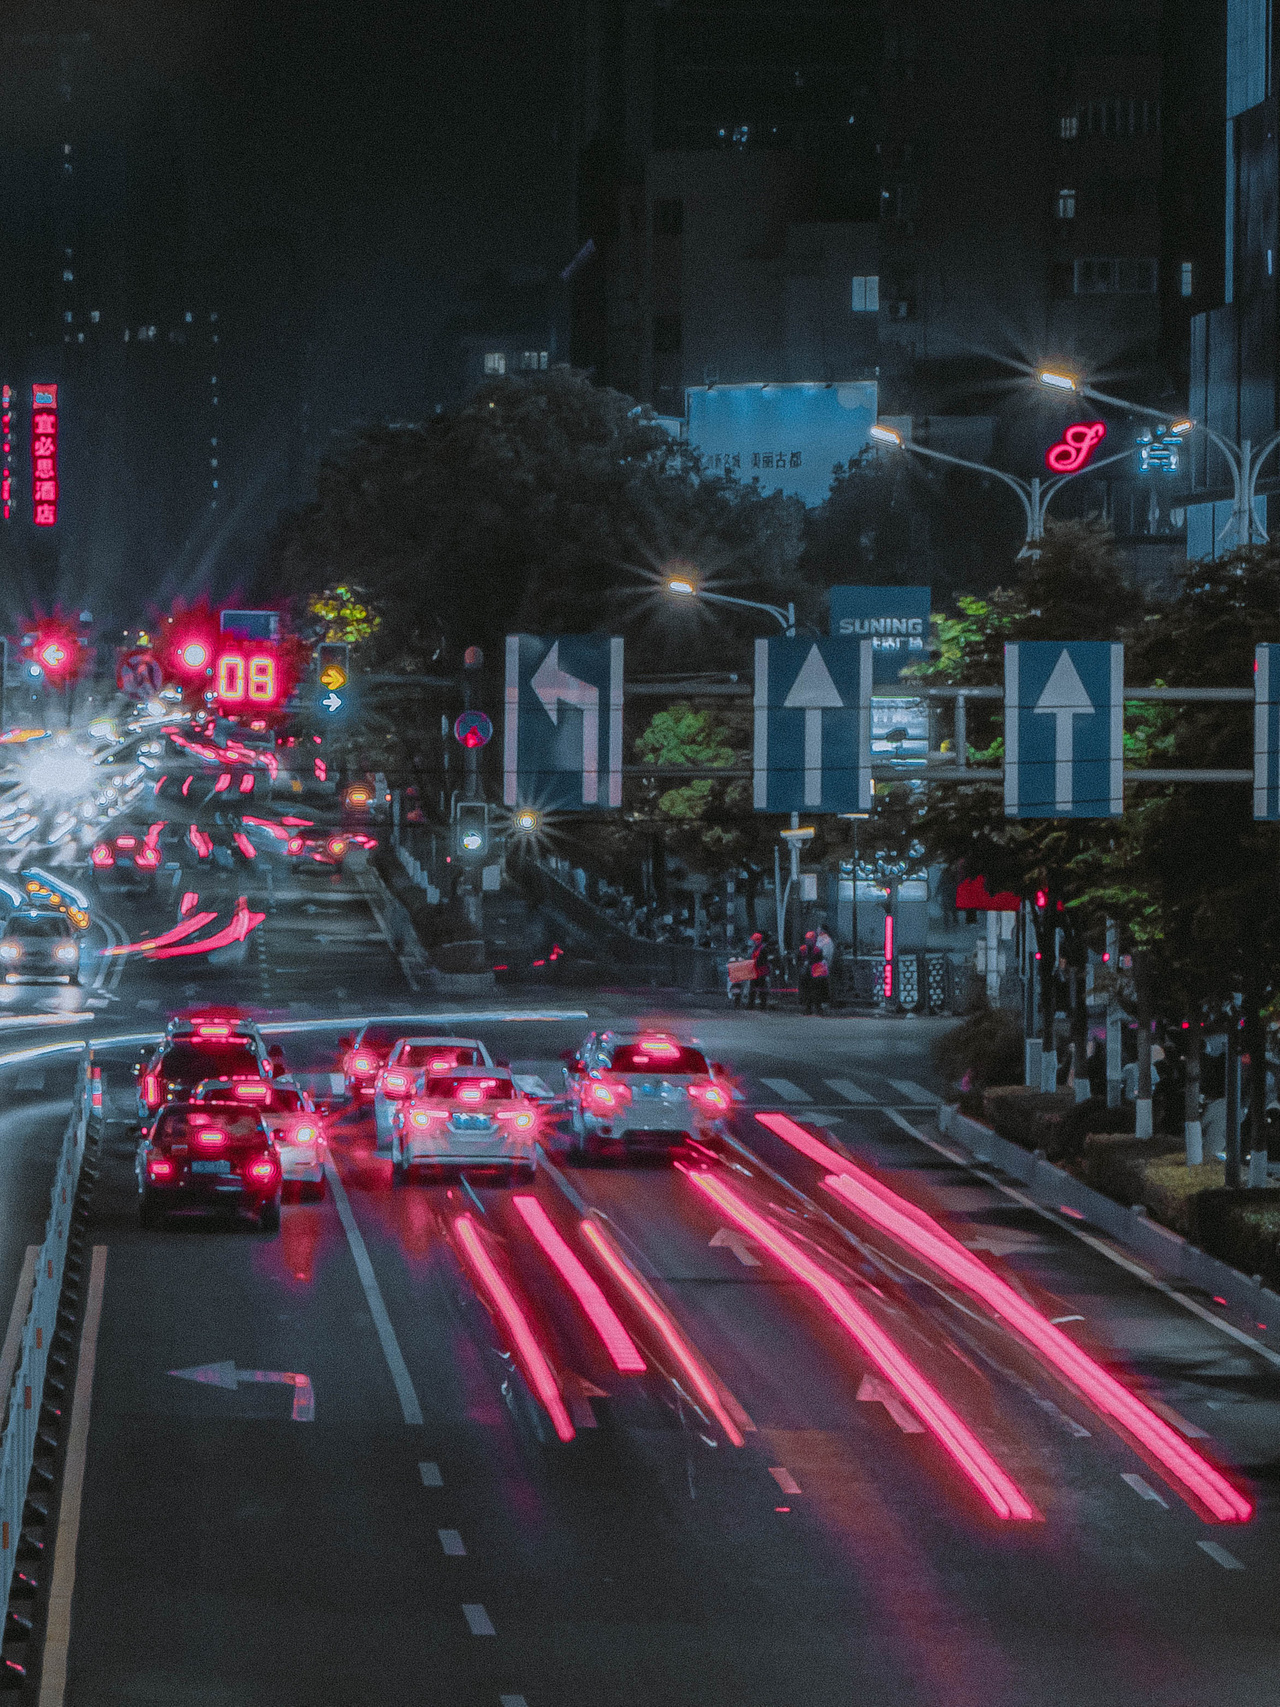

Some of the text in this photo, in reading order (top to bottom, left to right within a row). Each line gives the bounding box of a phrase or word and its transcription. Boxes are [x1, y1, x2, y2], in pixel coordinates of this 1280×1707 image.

[33, 412, 57, 525] 宜必思酒店
[839, 618, 923, 635] SUNING
